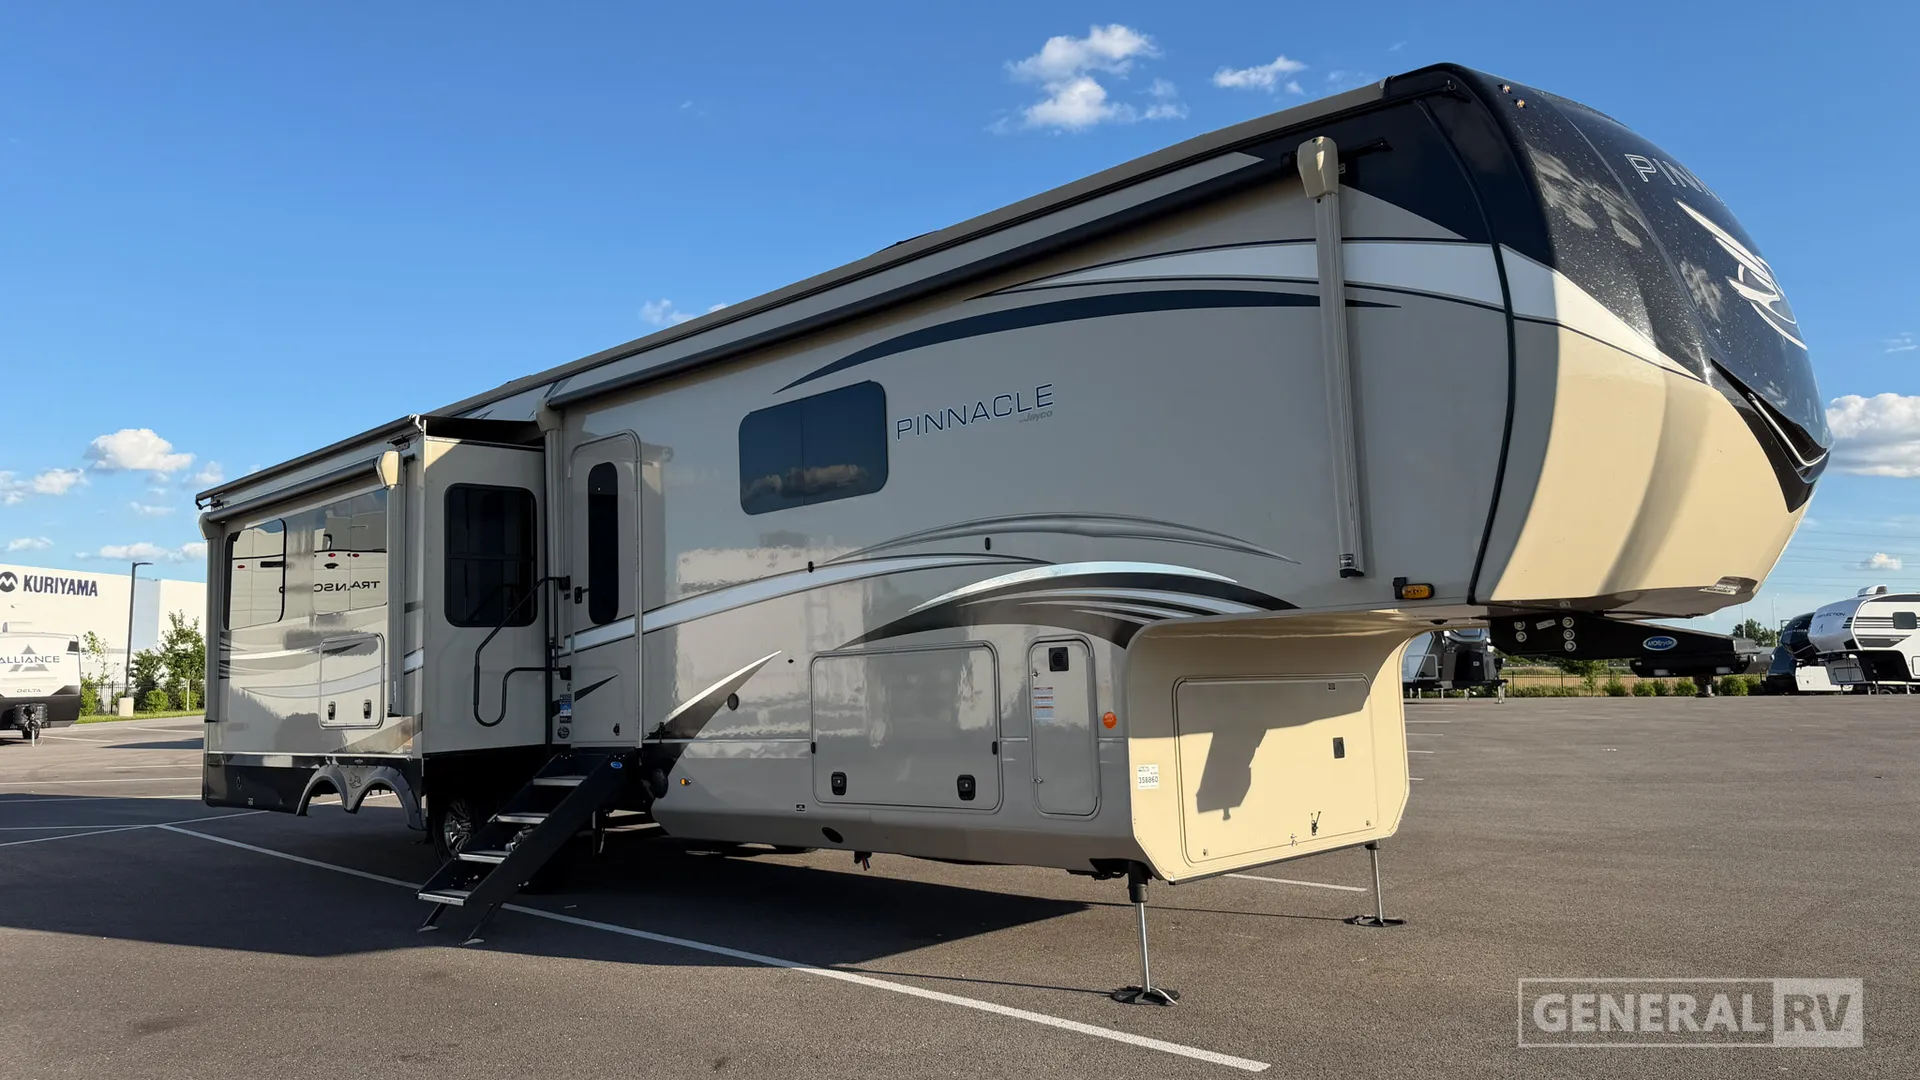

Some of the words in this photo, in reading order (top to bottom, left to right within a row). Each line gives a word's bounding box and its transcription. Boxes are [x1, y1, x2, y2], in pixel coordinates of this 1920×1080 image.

[897, 383, 1054, 441] PINNACLE
[23, 574, 98, 597] KURIYAMA
[0, 655, 60, 664] ALLIANCE
